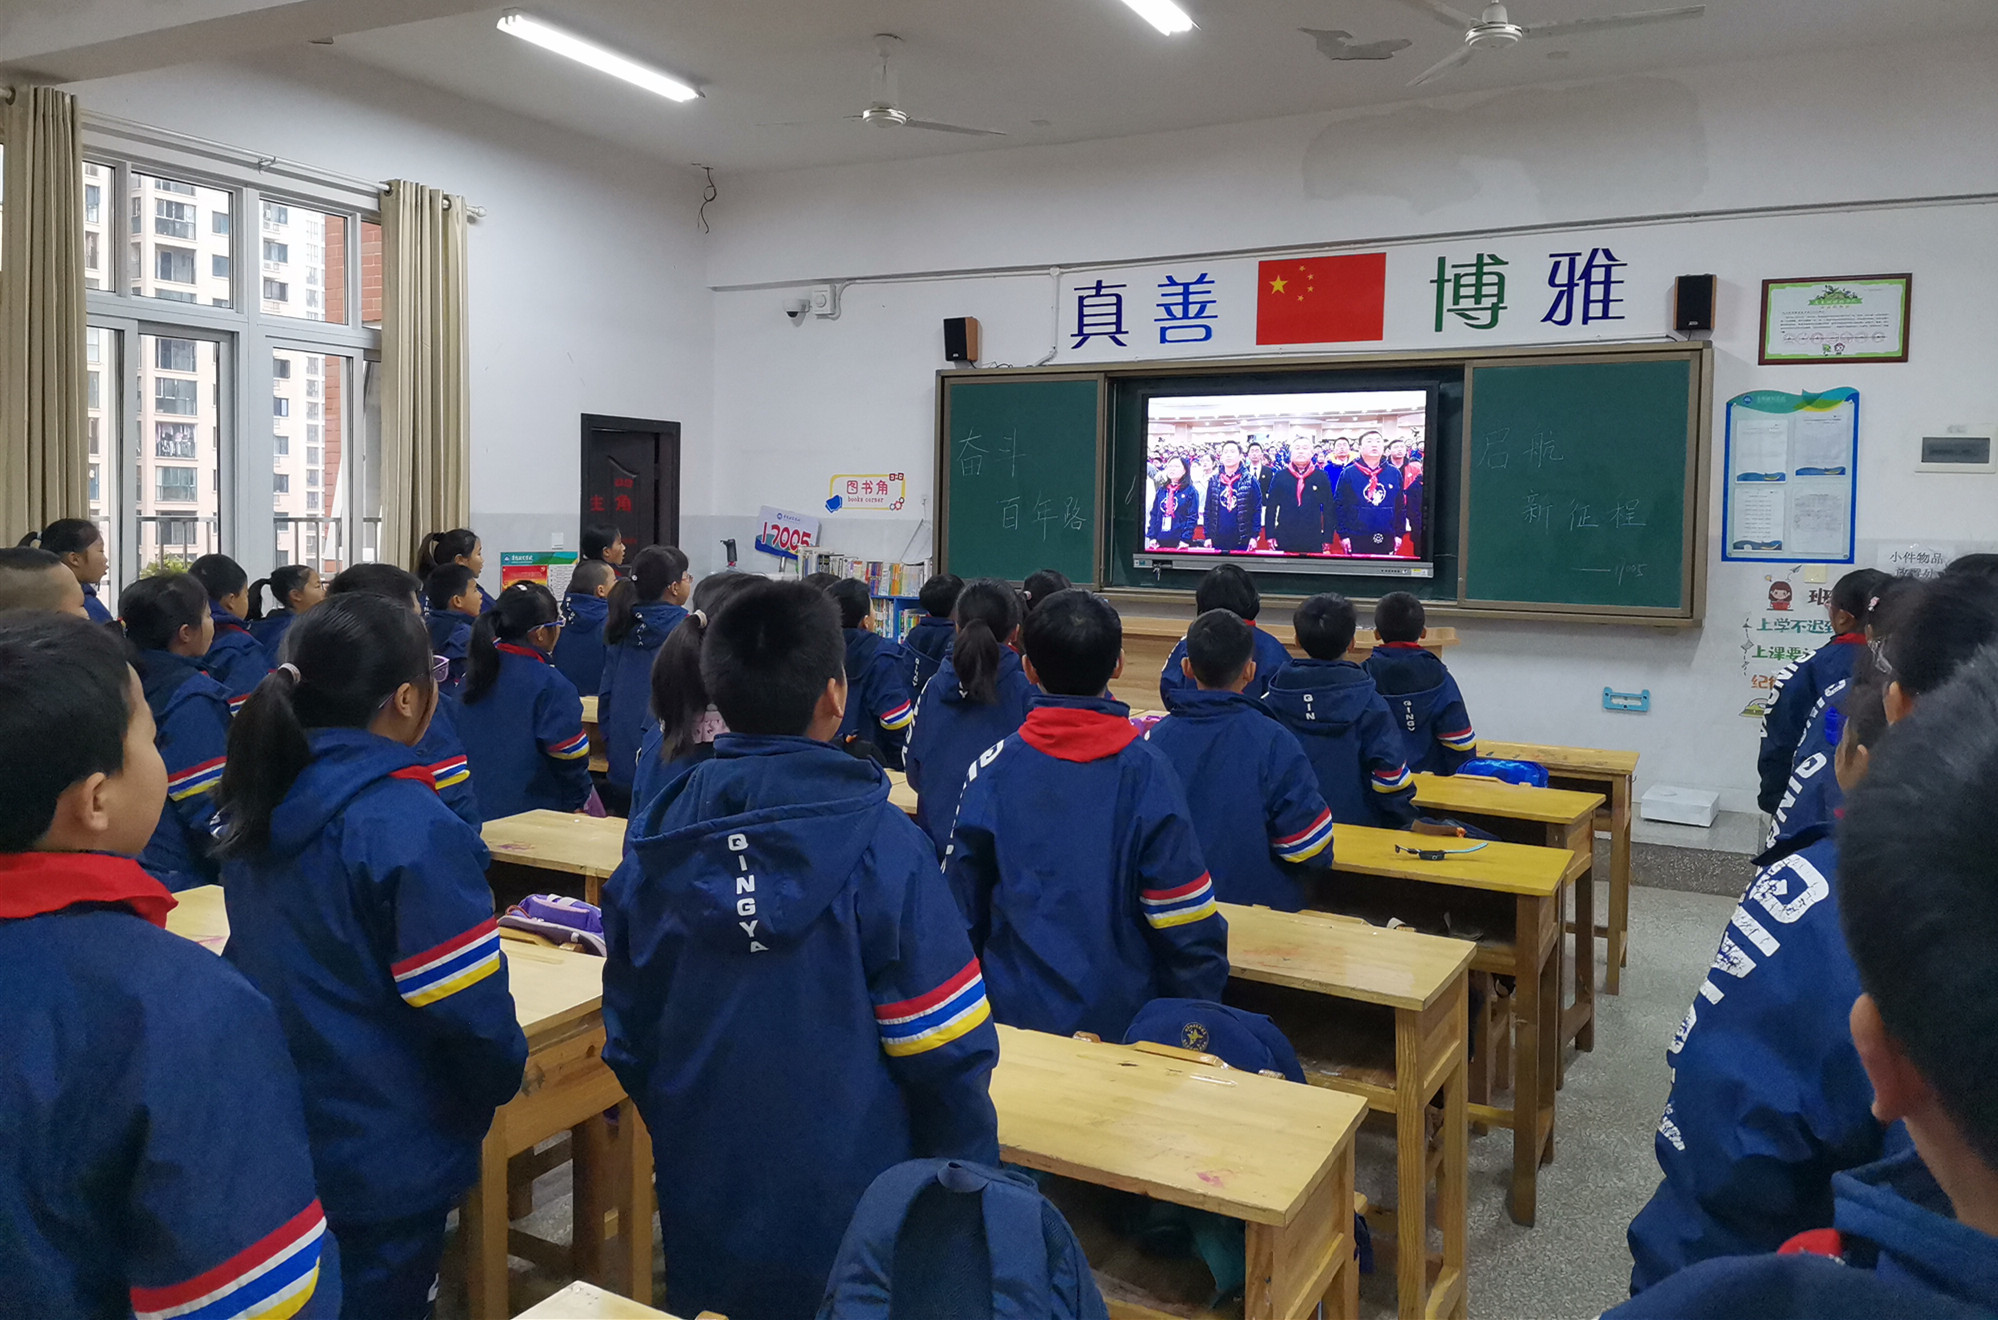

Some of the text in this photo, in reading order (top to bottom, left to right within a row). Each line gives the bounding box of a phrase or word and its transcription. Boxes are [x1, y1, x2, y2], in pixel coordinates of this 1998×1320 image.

[1070, 272, 1219, 348] 真善
[1429, 247, 1627, 332] 博雅
[957, 427, 1026, 478] 奋斗
[847, 480, 888, 495] 图书角
[848, 495, 863, 503] books
[996, 490, 1087, 543] 百年路
[1522, 489, 1647, 534] 新征程
[1889, 551, 1943, 564] 小件物品
[1752, 645, 1811, 661] 上课要
[1751, 674, 1776, 690] 纪
[728, 833, 770, 954] QINGYA
